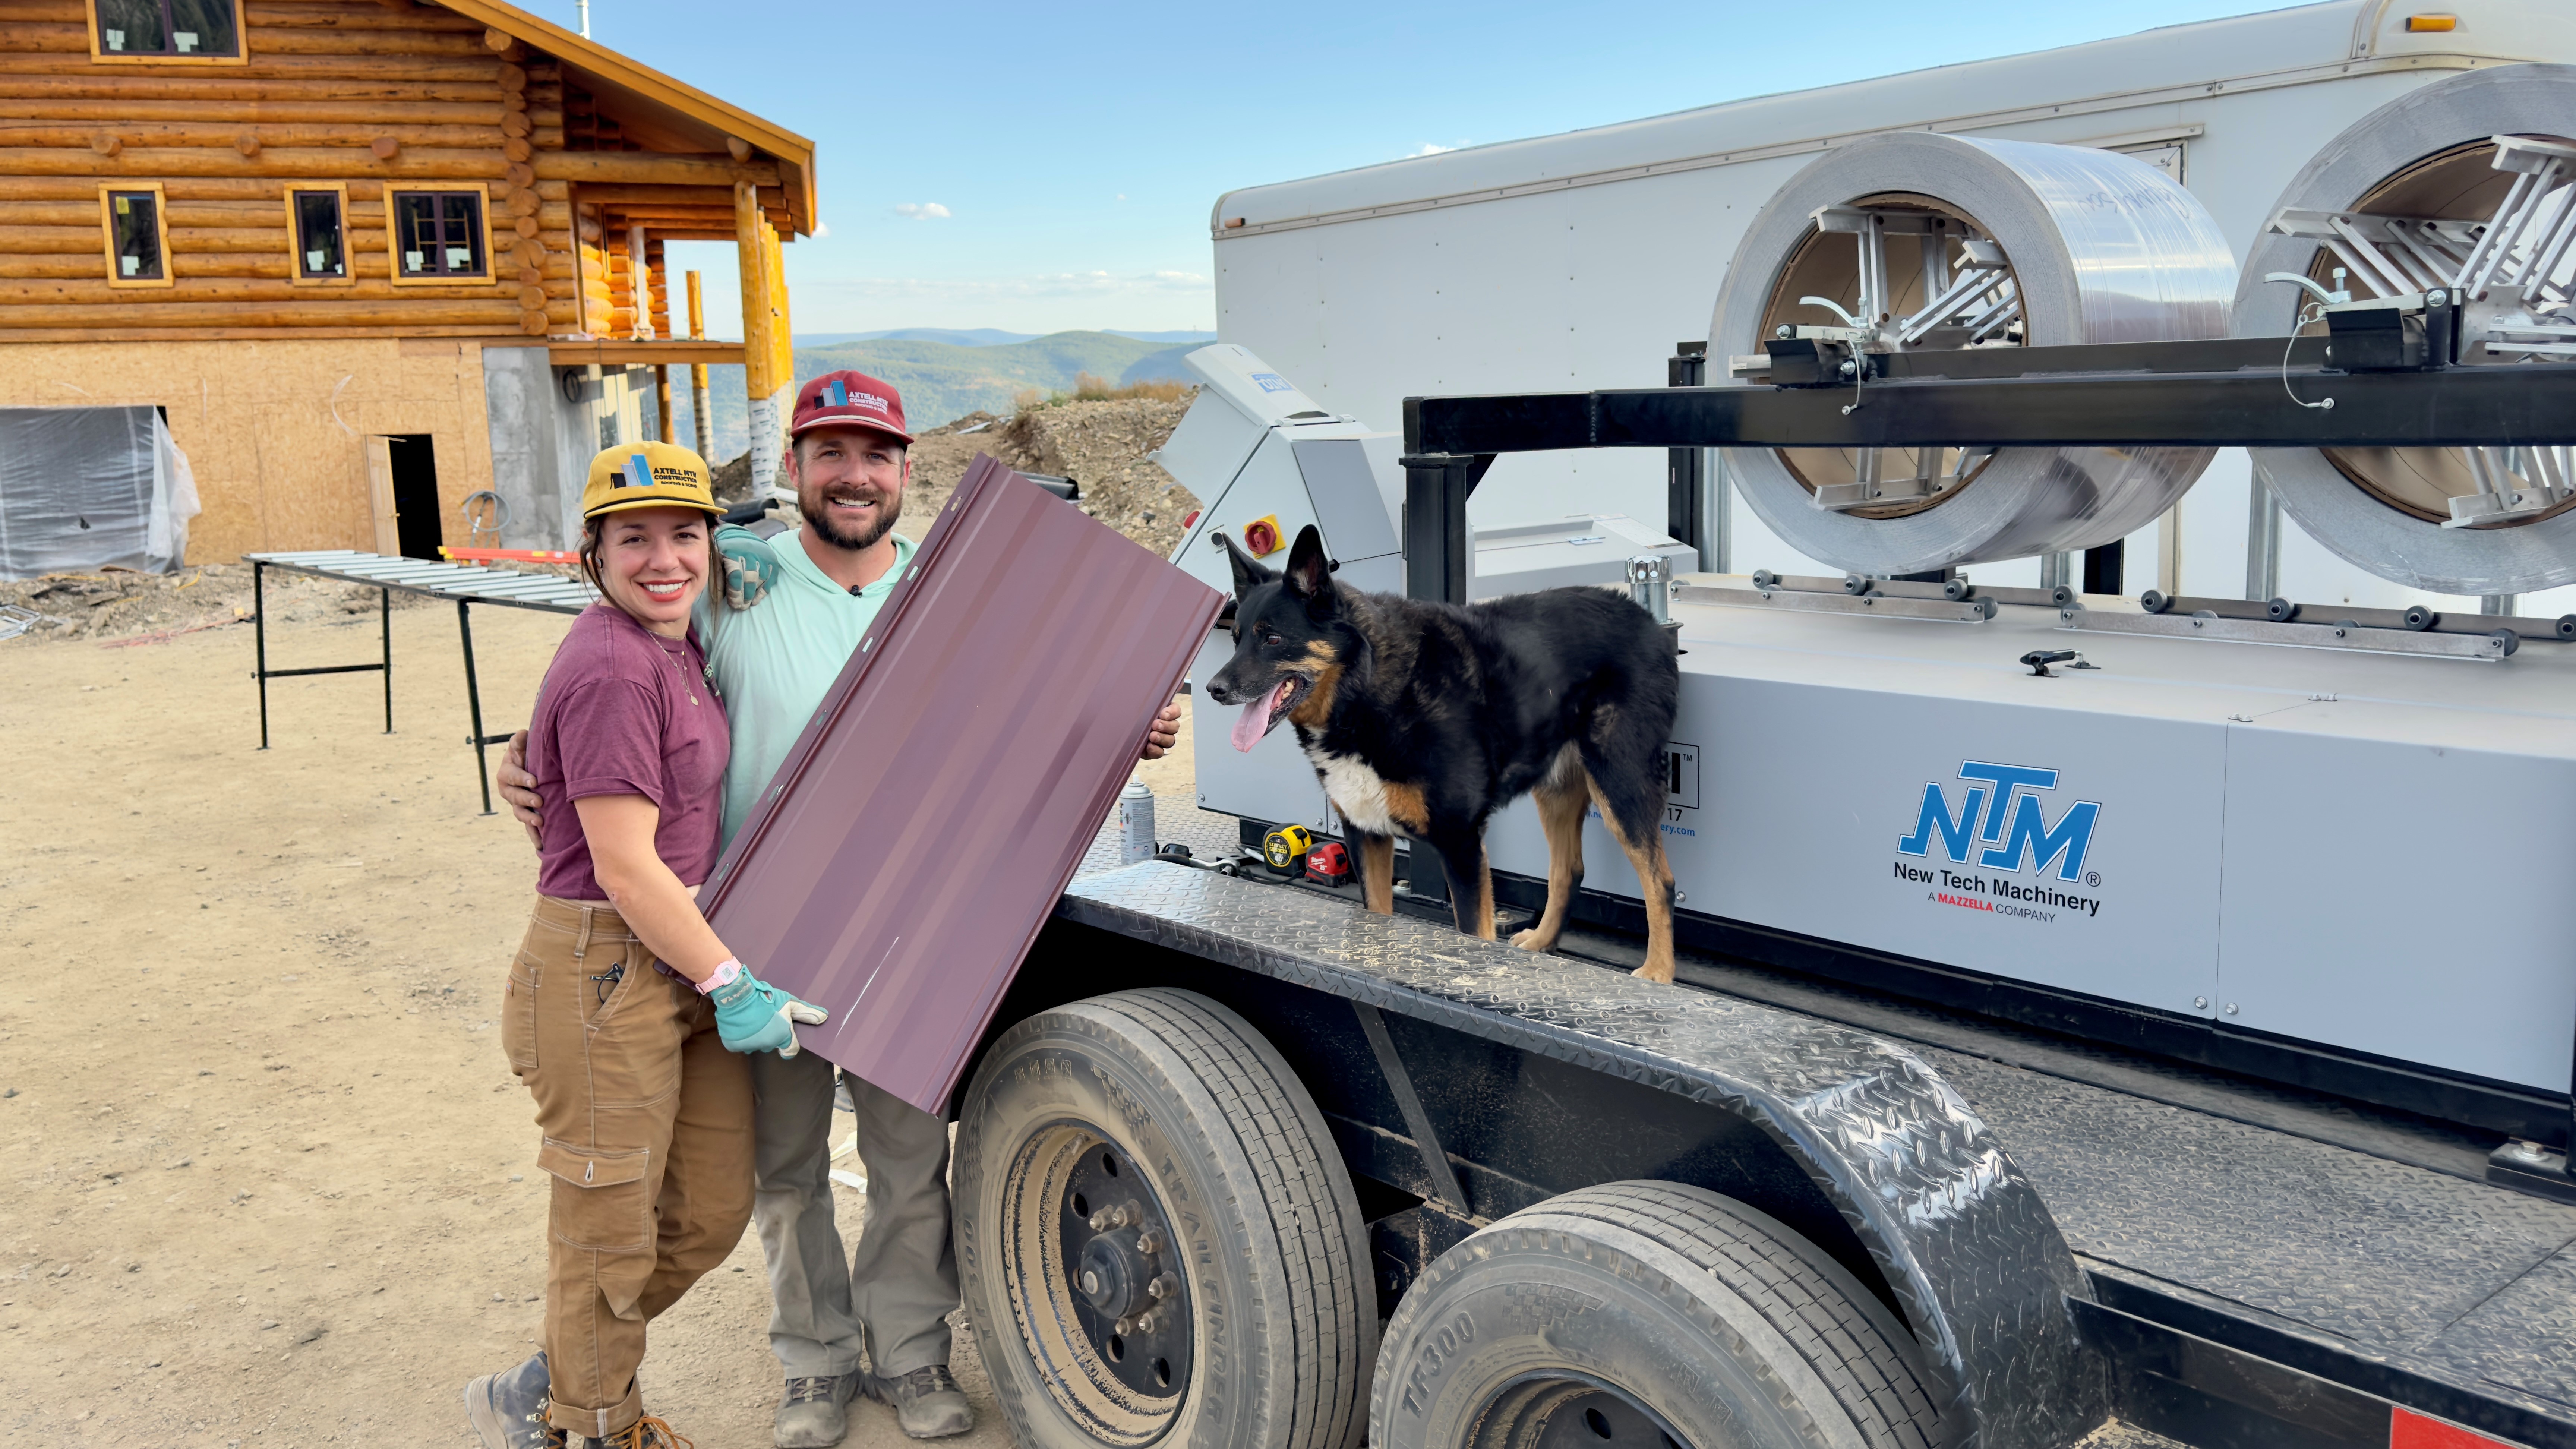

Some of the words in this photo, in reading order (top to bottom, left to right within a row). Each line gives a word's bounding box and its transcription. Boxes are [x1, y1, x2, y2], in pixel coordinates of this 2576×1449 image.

[849, 391, 877, 401] AXTELL
[654, 475, 697, 483] CONSTRUCTION
[1894, 862, 1933, 884] New
[1940, 869, 1986, 893] Tech
[1993, 878, 2100, 918] Machinery
[1928, 892, 1935, 902] A
[1938, 893, 1994, 913] MAZZELLA
[1996, 903, 2056, 924] COMPANY
[1161, 1153, 1228, 1425] TRAILFINDER
[1402, 1310, 1475, 1418] TF300
